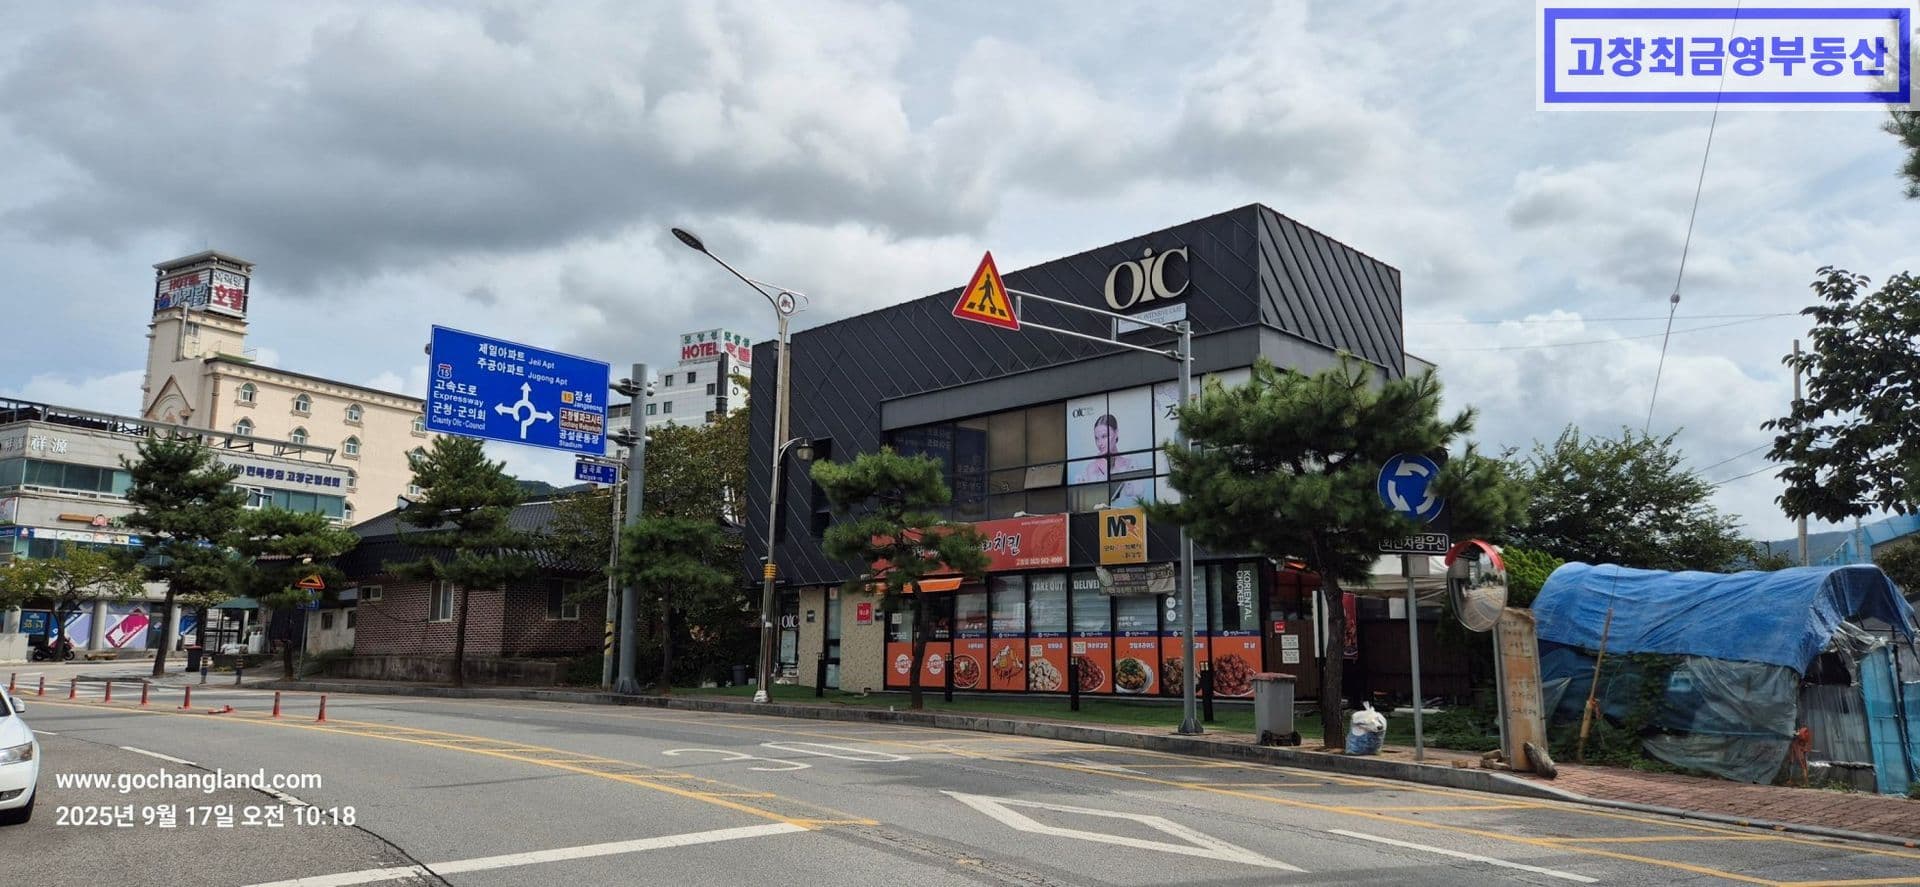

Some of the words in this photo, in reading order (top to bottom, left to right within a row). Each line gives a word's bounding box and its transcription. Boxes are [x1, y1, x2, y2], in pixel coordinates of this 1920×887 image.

[213, 284, 243, 310] 호텔
[478, 343, 525, 362] 제일아파트
[682, 342, 719, 360] HOTEL
[477, 357, 525, 377] 주공아파트
[528, 357, 541, 366] Jeil
[542, 360, 555, 370] Apt
[528, 371, 554, 385] Jugong
[555, 377, 568, 386] Apt
[434, 379, 477, 396] 고속도로
[433, 390, 484, 408] Expressway
[575, 390, 593, 403] 장성
[432, 414, 451, 427] County
[558, 440, 583, 449] Stadium
[560, 430, 599, 445] 공설운동장
[1382, 535, 1446, 551] 회전차량우선
[1032, 581, 1049, 592] TAKE
[1050, 580, 1065, 591] OUT
[1236, 570, 1244, 606] CHICKEN
[1243, 570, 1252, 621] KORIENTAL
